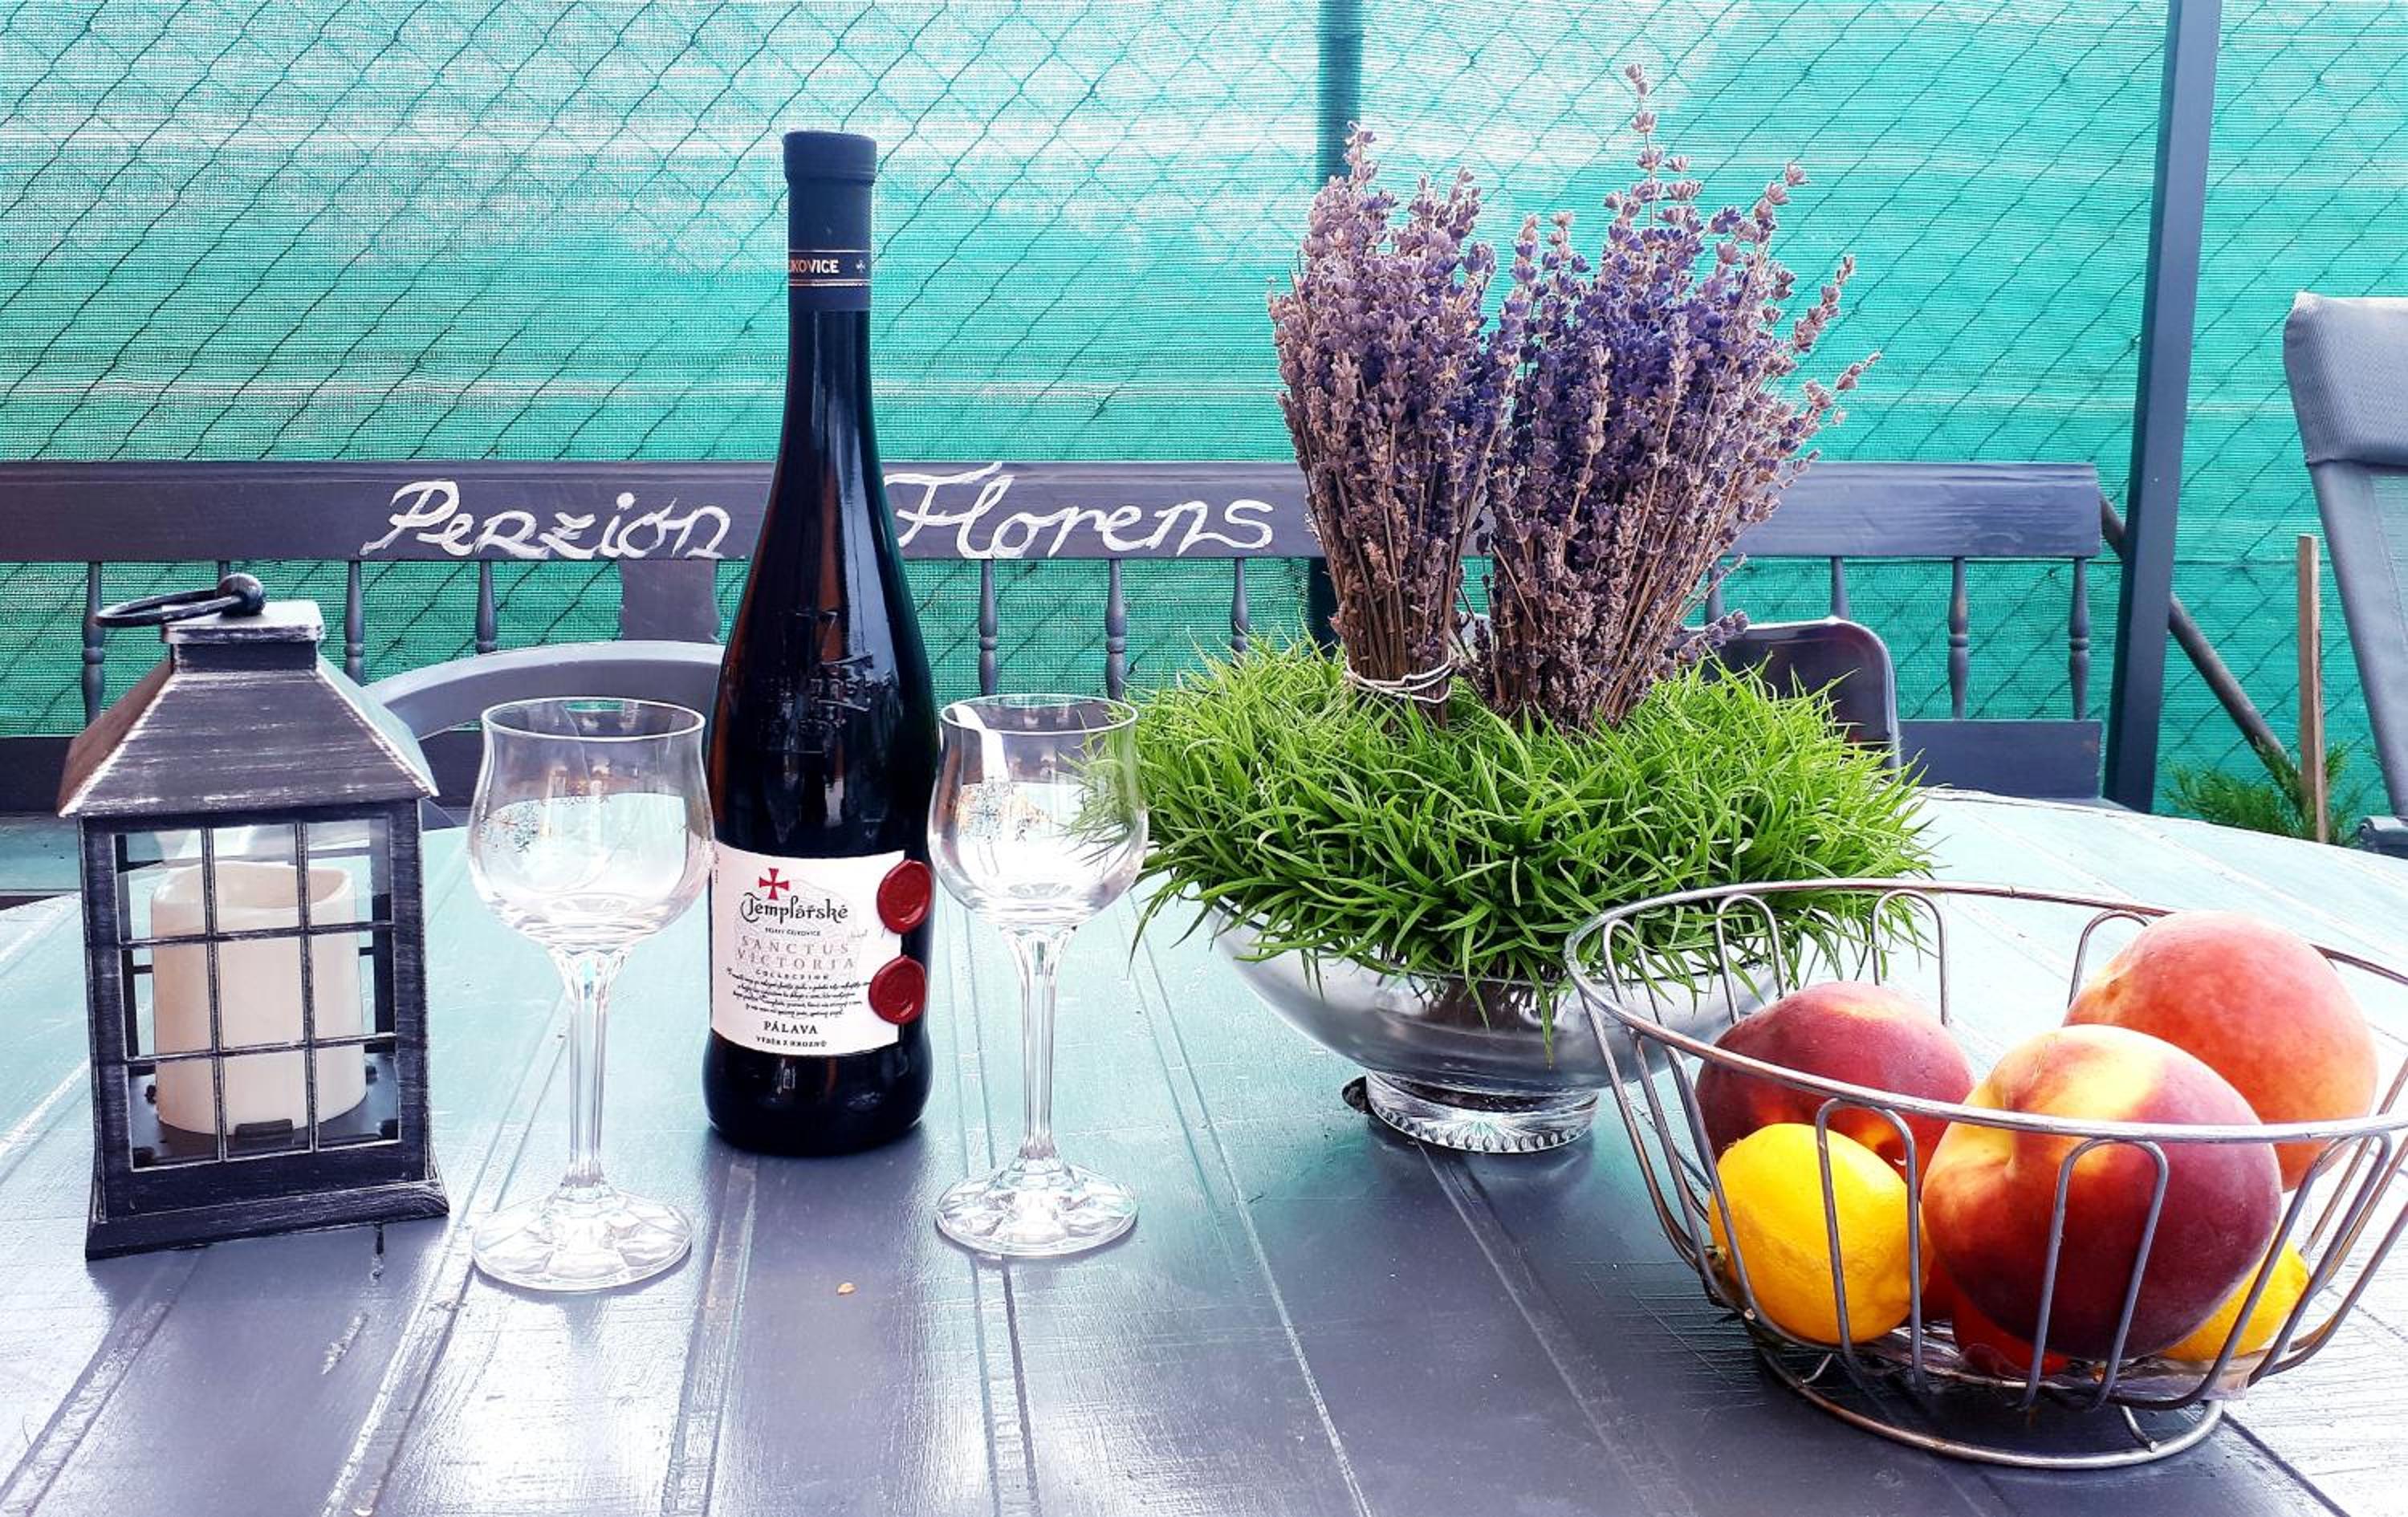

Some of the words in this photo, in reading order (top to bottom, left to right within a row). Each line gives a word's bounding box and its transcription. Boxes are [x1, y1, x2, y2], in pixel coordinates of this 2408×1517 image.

[883, 462, 1274, 559] Florens
[742, 935, 849, 954] SANCTUS
[738, 949, 855, 970] VICTORIA
[763, 1020, 818, 1035] PÁLAVA
